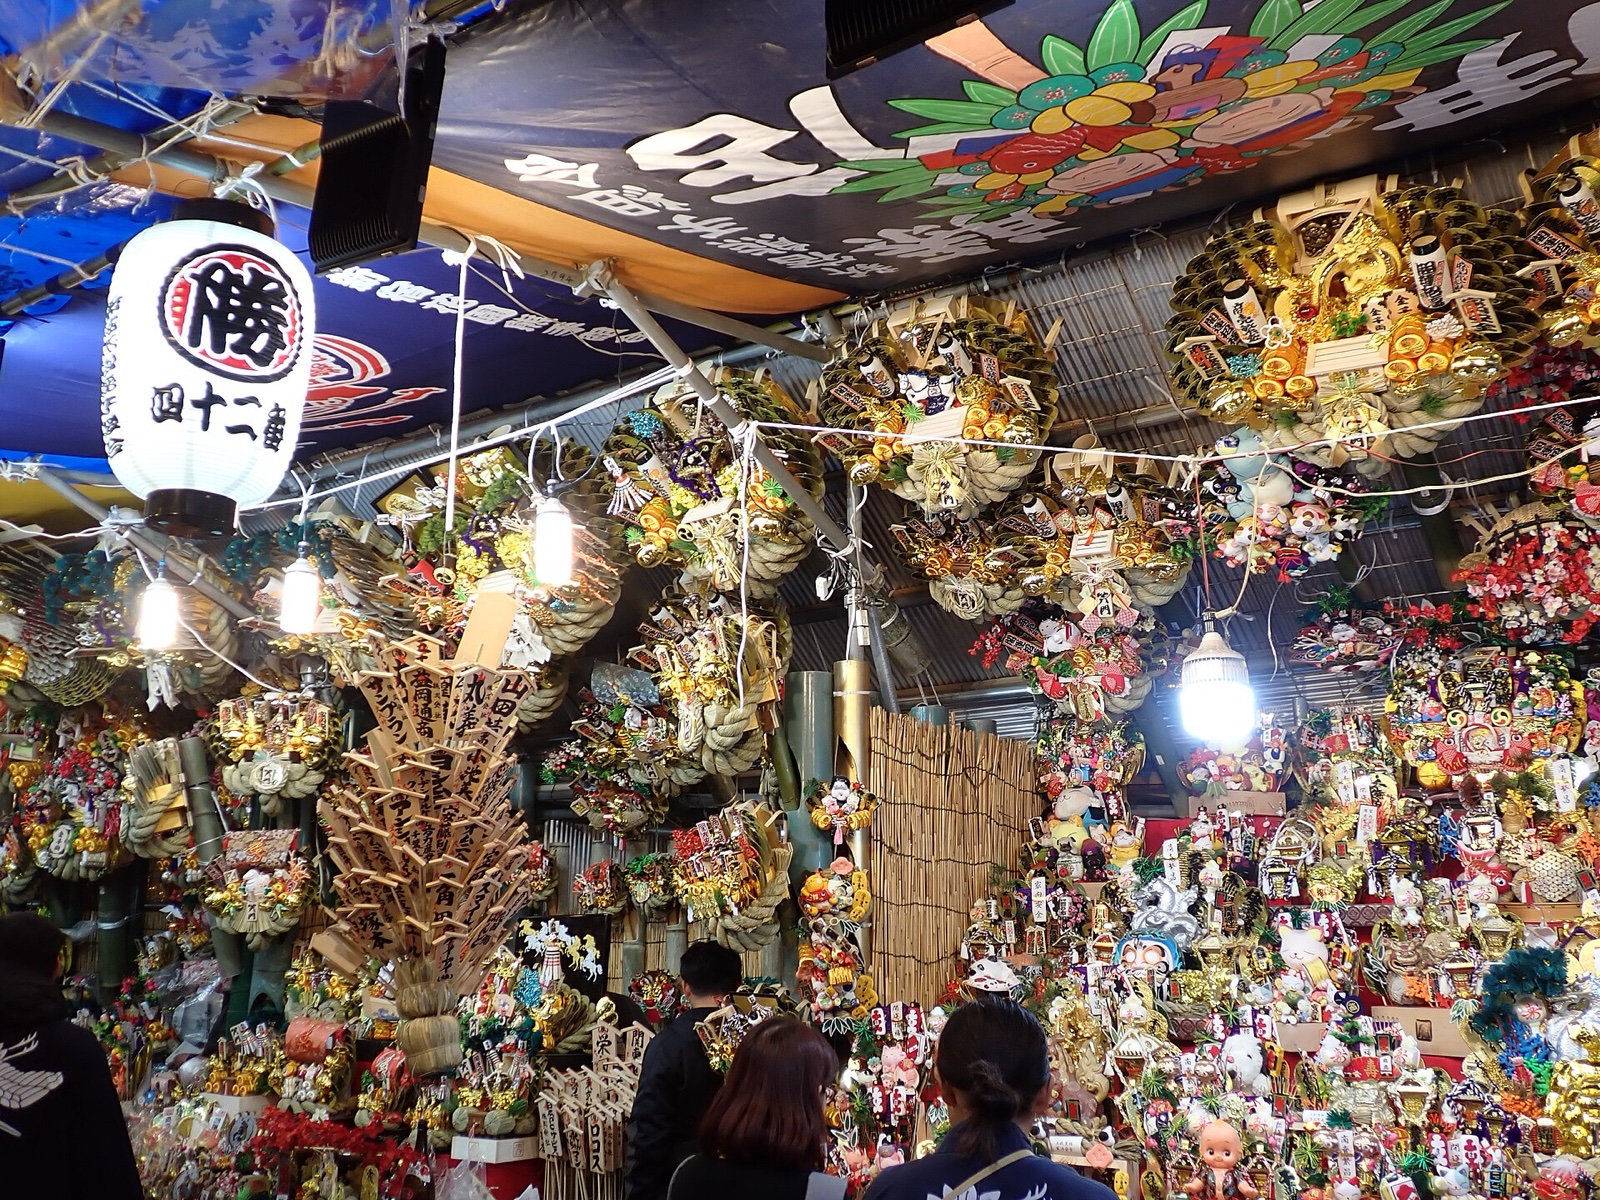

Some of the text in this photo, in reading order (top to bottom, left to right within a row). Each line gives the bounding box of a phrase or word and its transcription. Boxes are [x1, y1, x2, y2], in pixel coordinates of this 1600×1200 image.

[184, 258, 288, 368] 勝
[150, 380, 288, 453] 四十二番
[367, 677, 407, 745] サンプラン
[1034, 879, 1044, 919] 家内安全
[590, 1124, 605, 1173] ロコス
